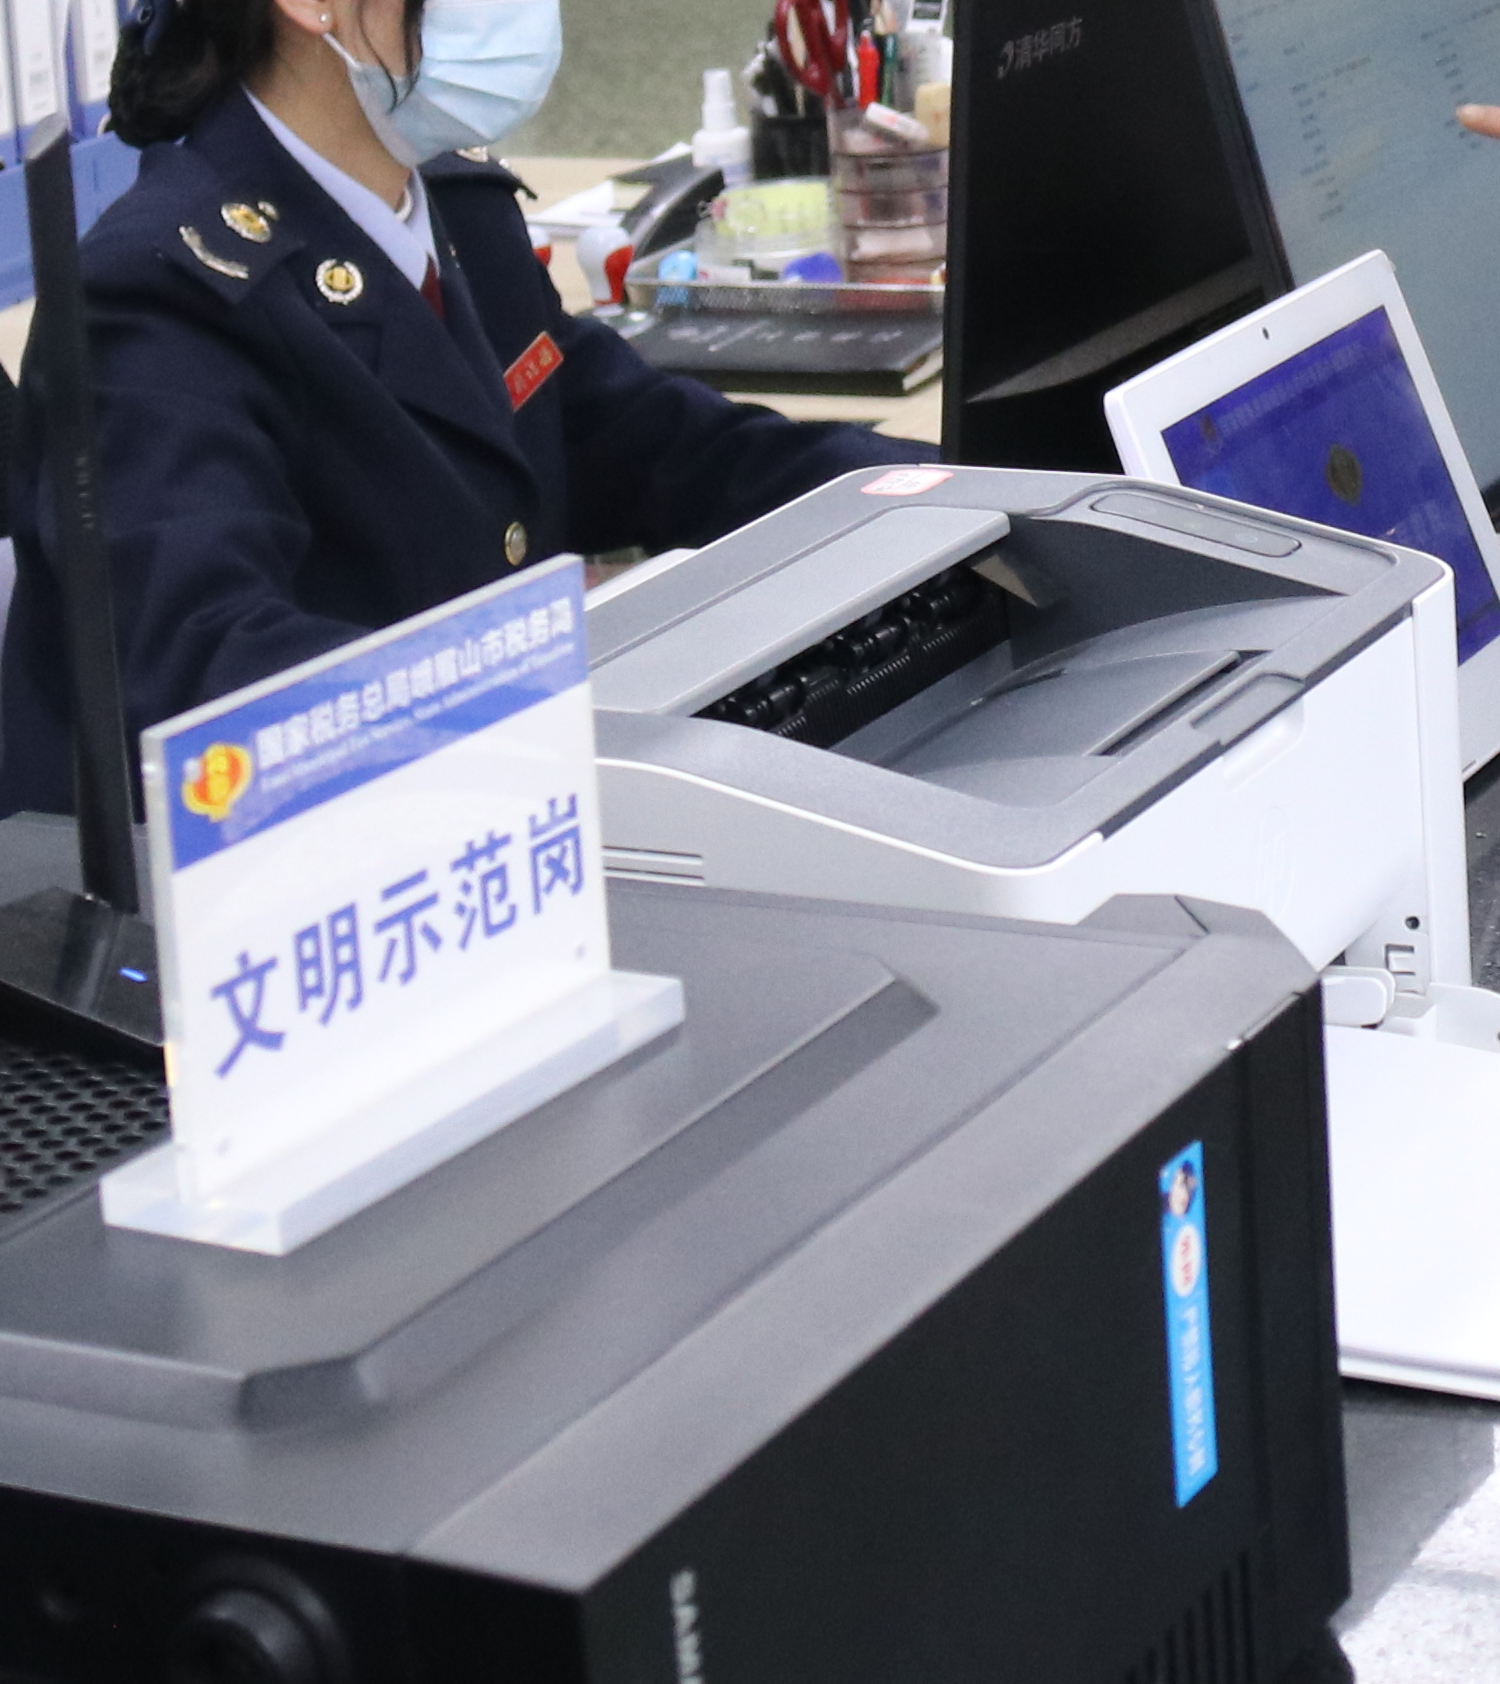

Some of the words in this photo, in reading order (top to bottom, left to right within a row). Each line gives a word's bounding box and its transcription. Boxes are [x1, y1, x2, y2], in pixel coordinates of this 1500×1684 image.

[209, 791, 588, 1079] 文明示范岗
